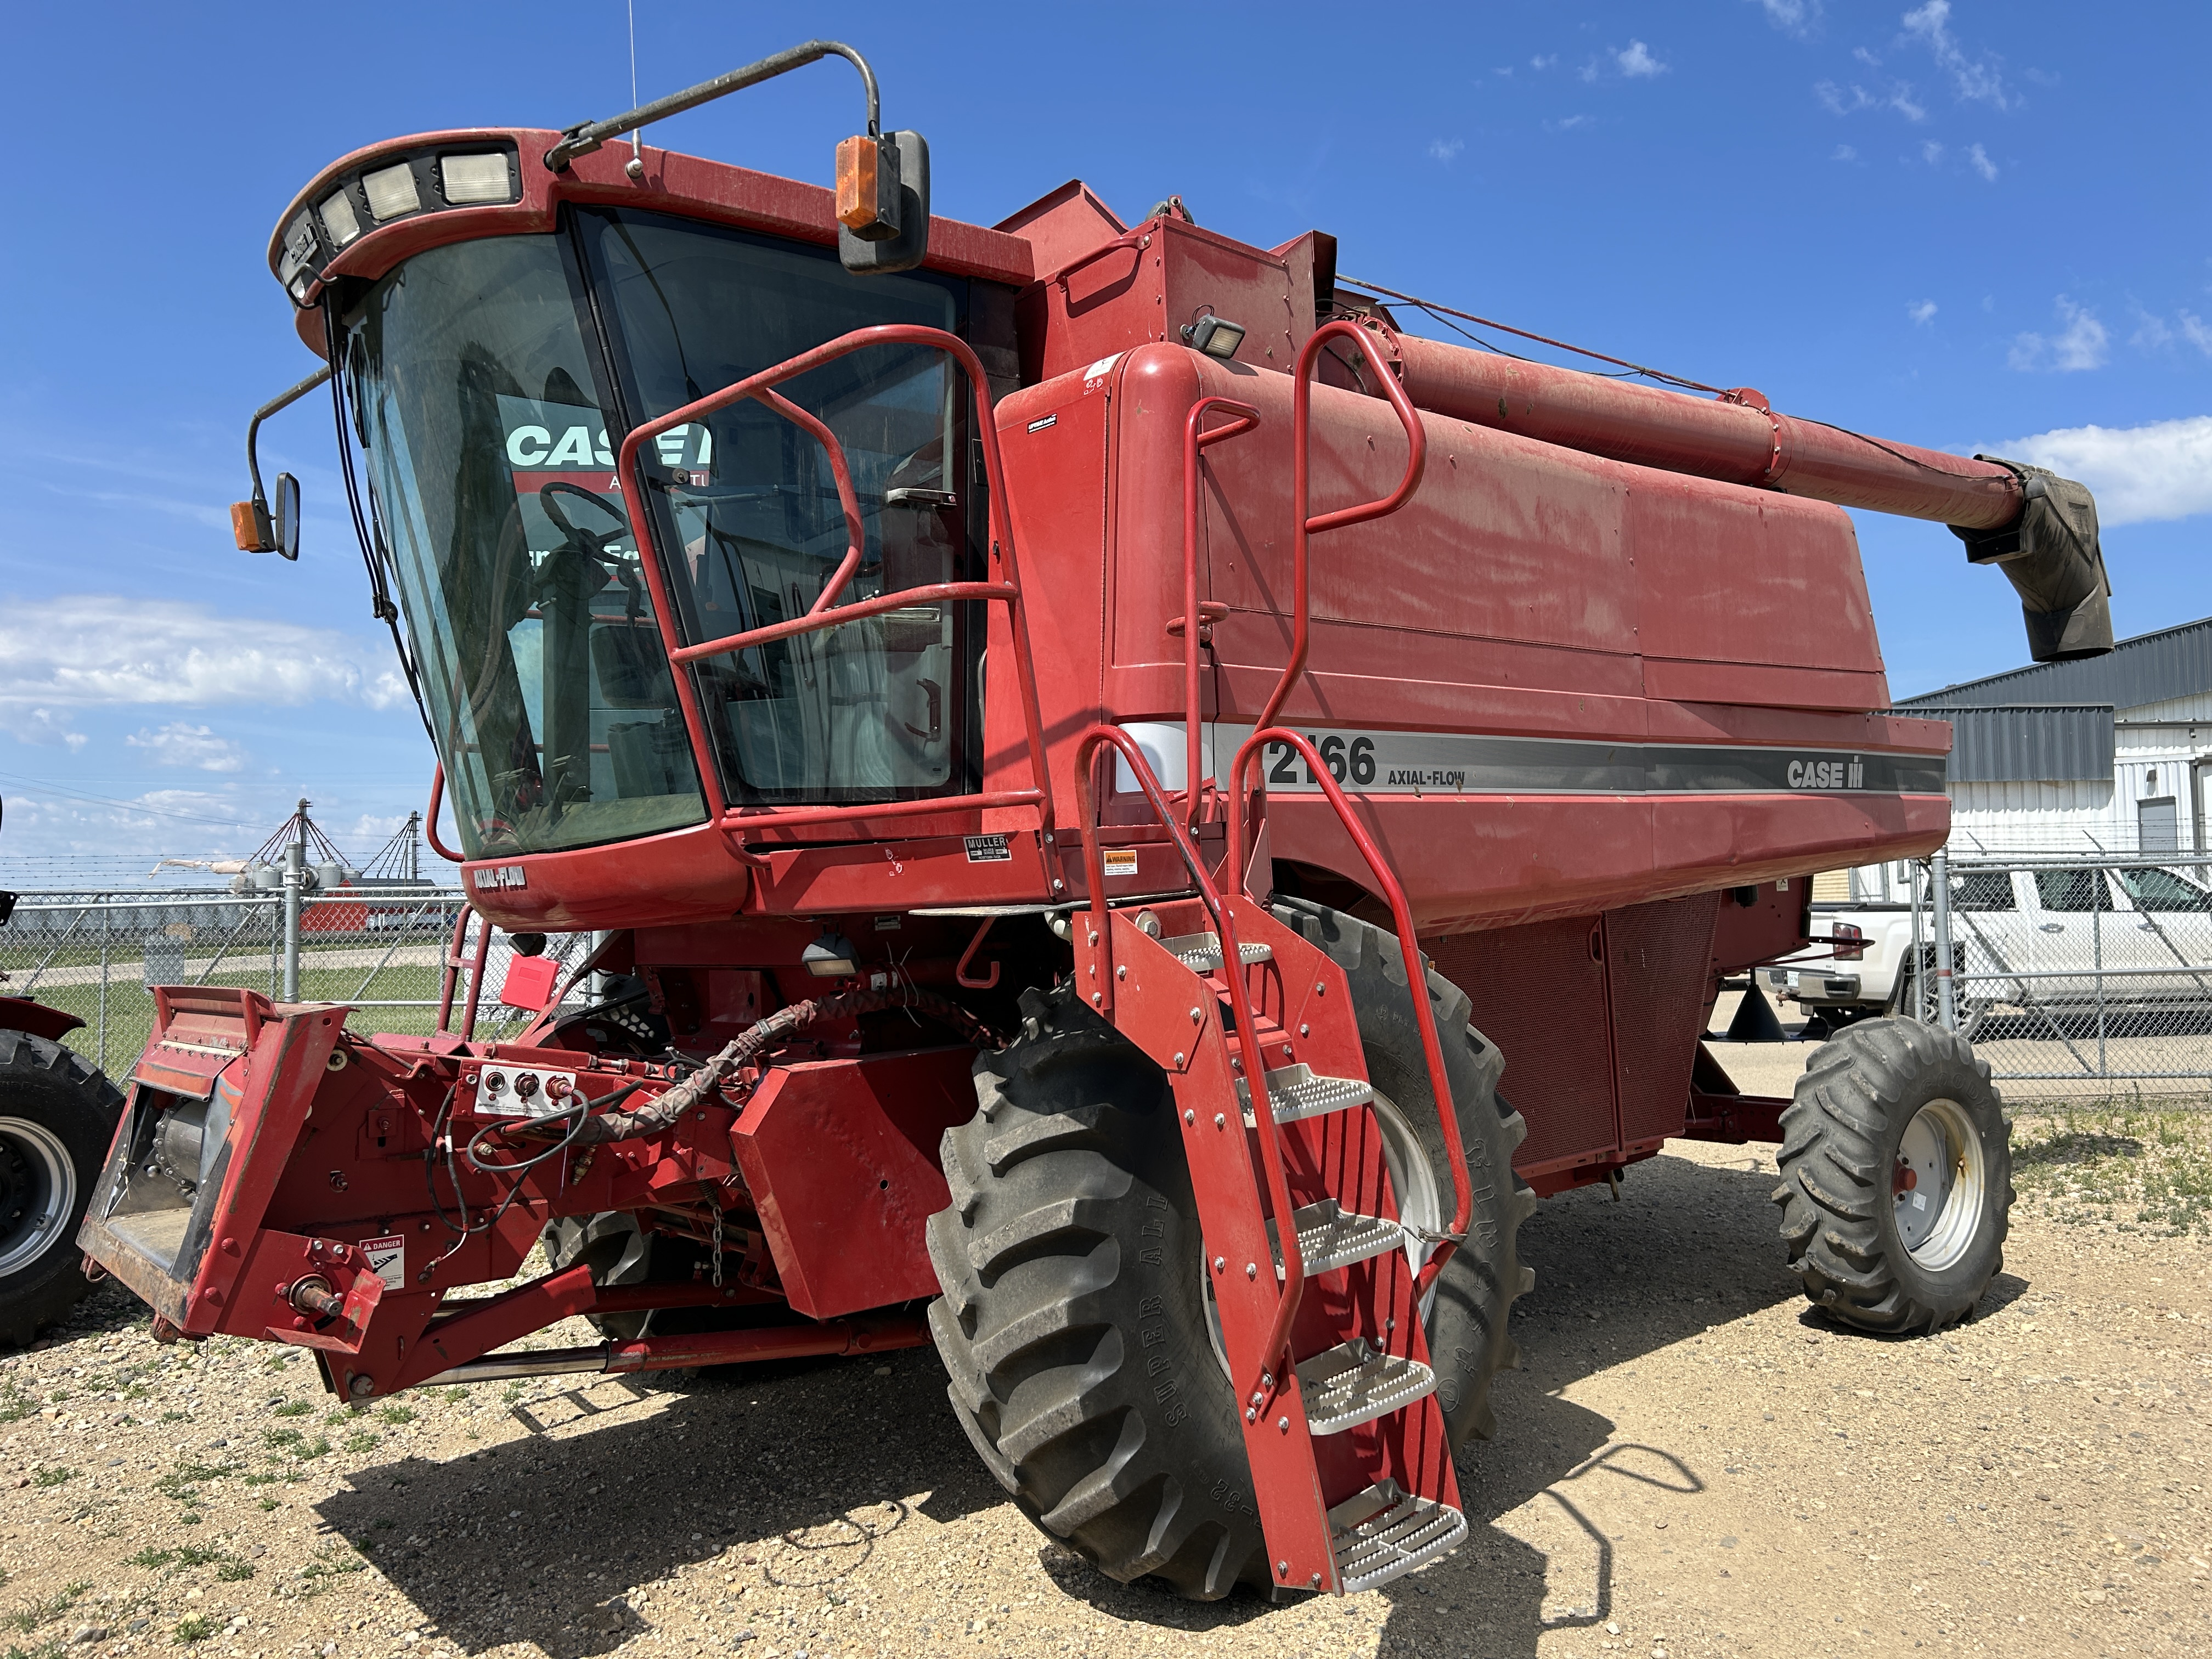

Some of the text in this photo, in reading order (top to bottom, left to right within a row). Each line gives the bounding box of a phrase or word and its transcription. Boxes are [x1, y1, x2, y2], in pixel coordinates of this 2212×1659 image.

[1269, 735, 1376, 785] 2166
[1787, 759, 1843, 788] CASE
[1388, 770, 1465, 786] AXIAL-FLOW
[967, 837, 1006, 849] MULLER
[1140, 1193, 1169, 1265] ALL
[373, 1240, 400, 1250] DANGER
[1139, 1294, 1191, 1427] SUPER
